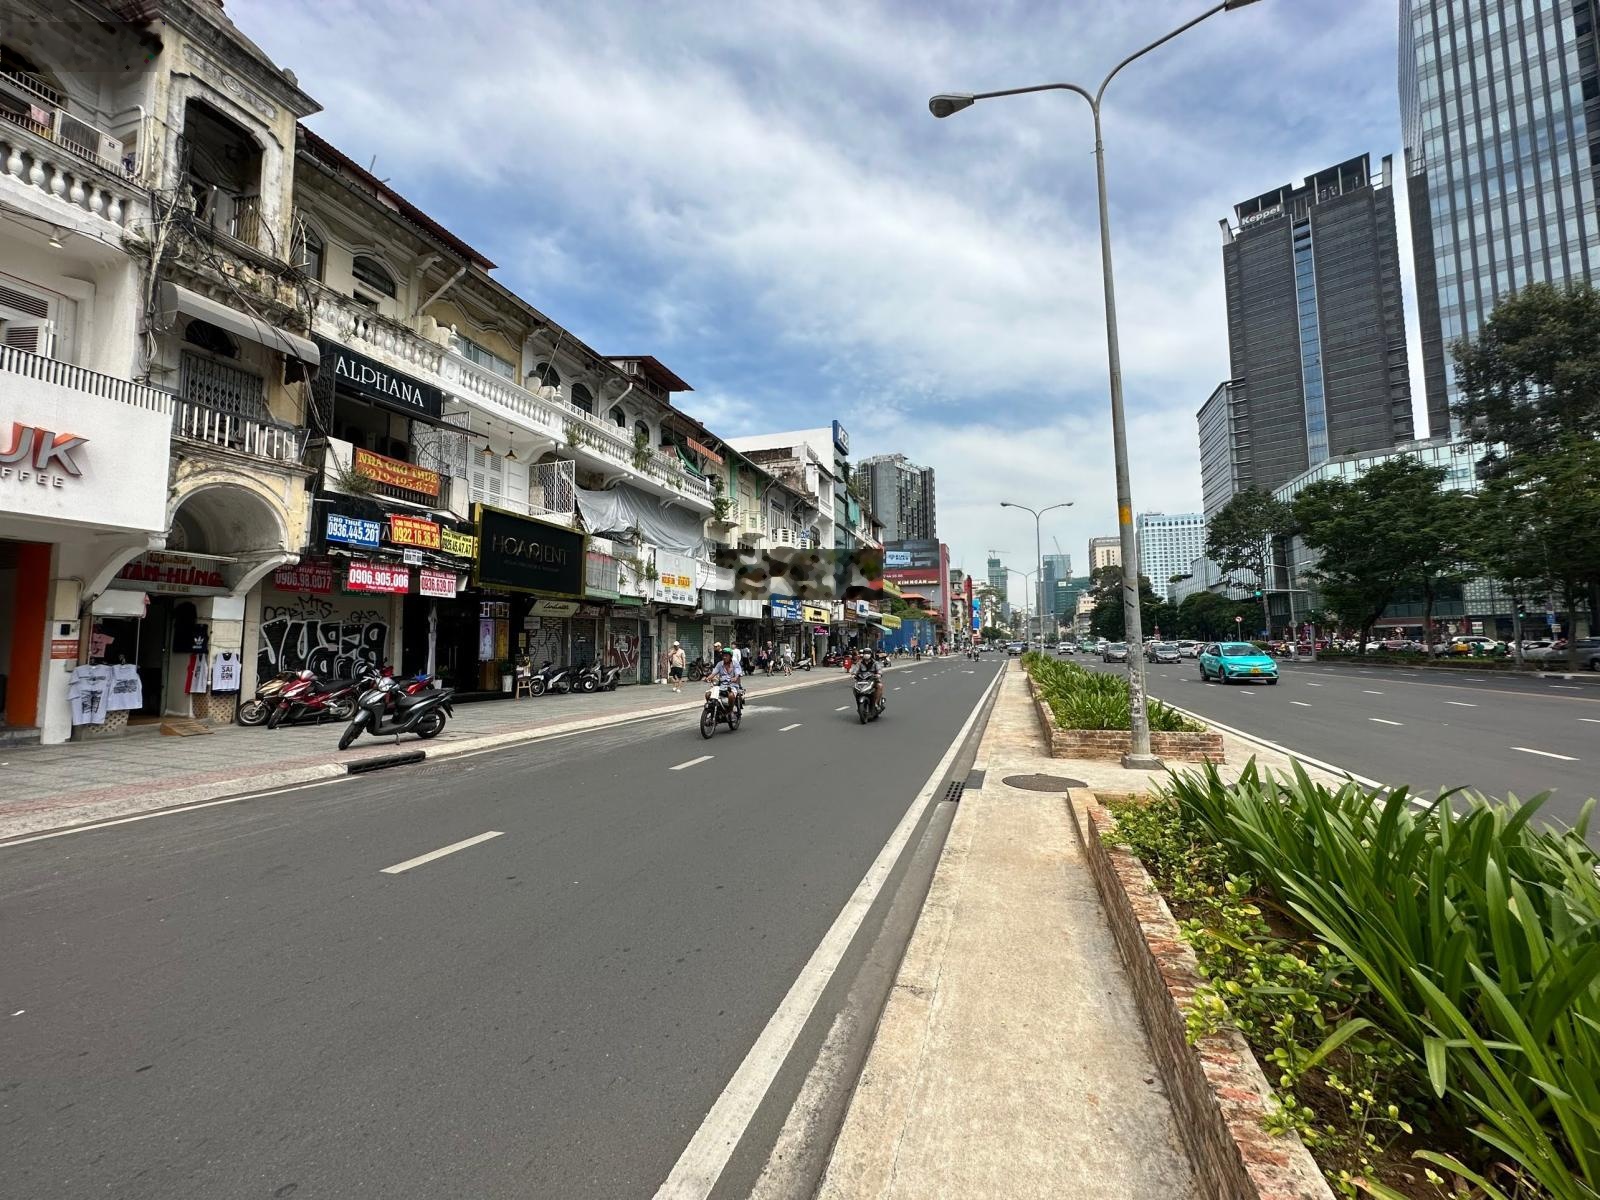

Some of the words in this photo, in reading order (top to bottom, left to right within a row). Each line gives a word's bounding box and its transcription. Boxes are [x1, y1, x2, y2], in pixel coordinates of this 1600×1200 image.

[1241, 204, 1280, 225] Keppel
[385, 461, 409, 476] CHO
[328, 515, 344, 524] CHO
[327, 521, 379, 543] 0936.445.201
[349, 568, 409, 588] 0906.905.006
